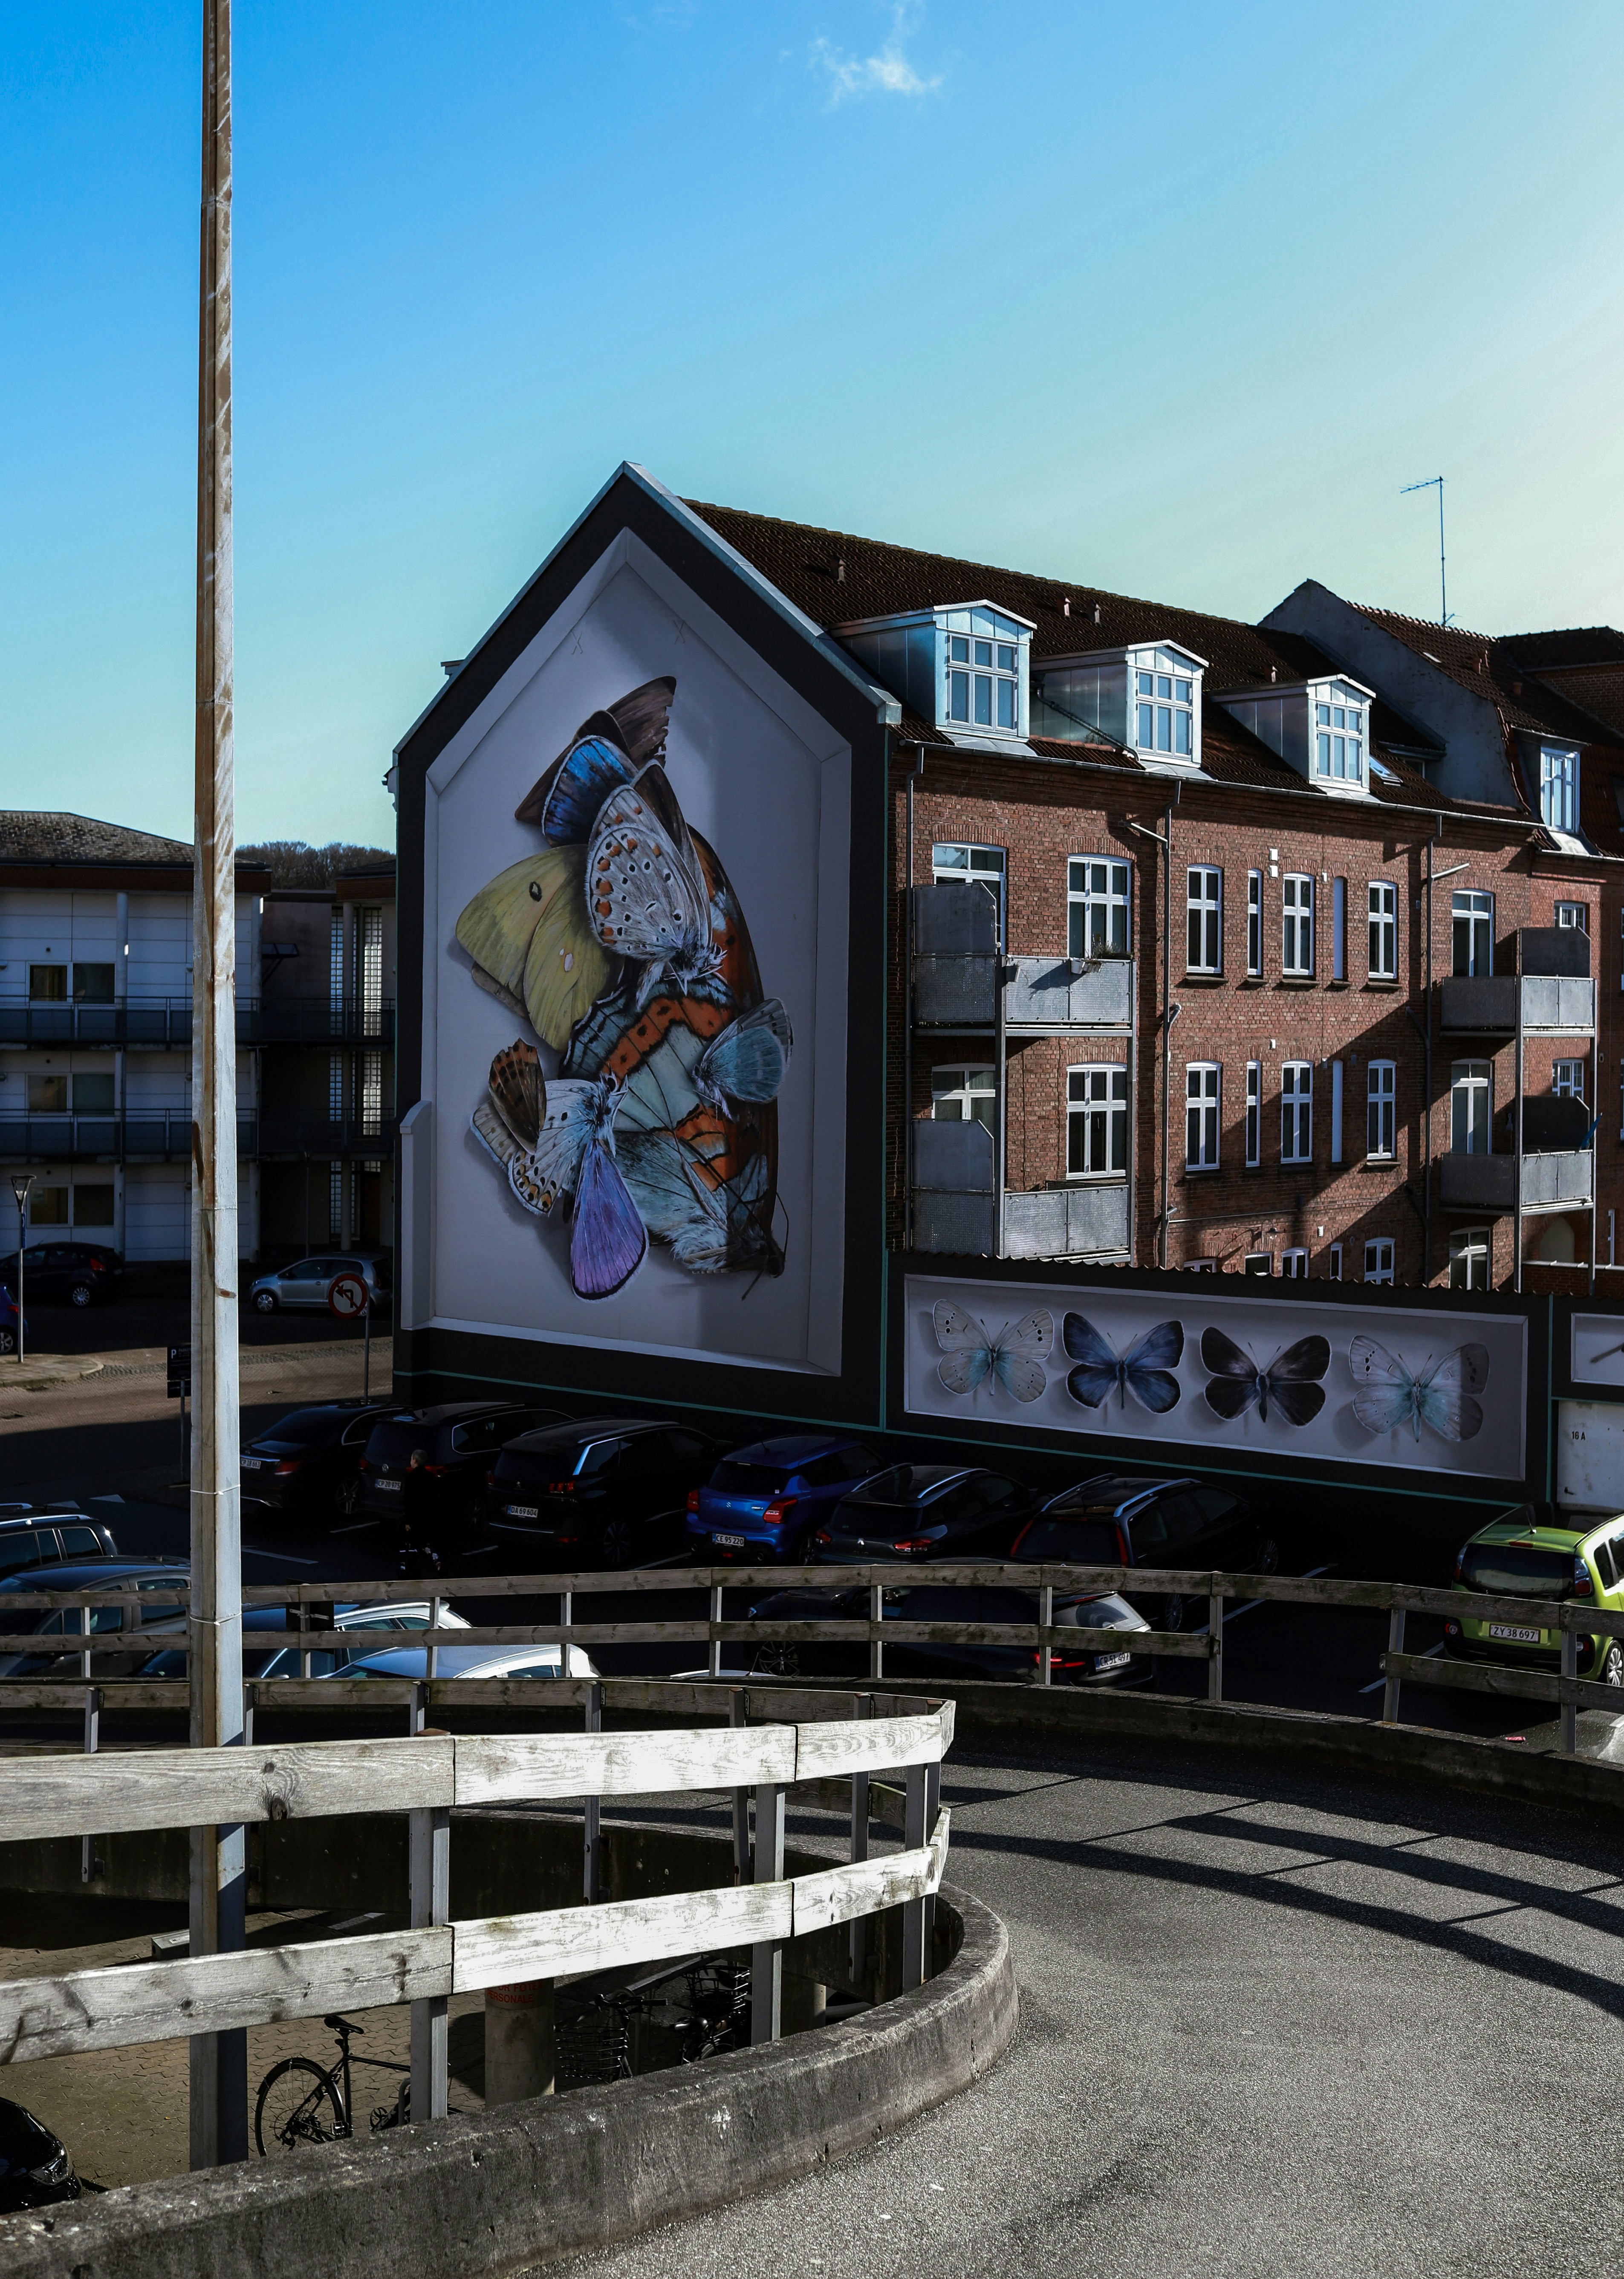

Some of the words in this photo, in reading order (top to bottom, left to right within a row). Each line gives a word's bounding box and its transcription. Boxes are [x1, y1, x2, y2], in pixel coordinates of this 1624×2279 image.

[171, 1349, 177, 1359] P
[1581, 1432, 1586, 1440] A
[733, 1537, 743, 1545] 220
[1494, 1626, 1505, 1636] ZY
[1507, 1628, 1517, 1637] 38
[1519, 1629, 1536, 1640] 697
[1100, 1656, 1108, 1666] CR
[1110, 1654, 1117, 1664] 51
[487, 1988, 533, 2003] PERSONALE
